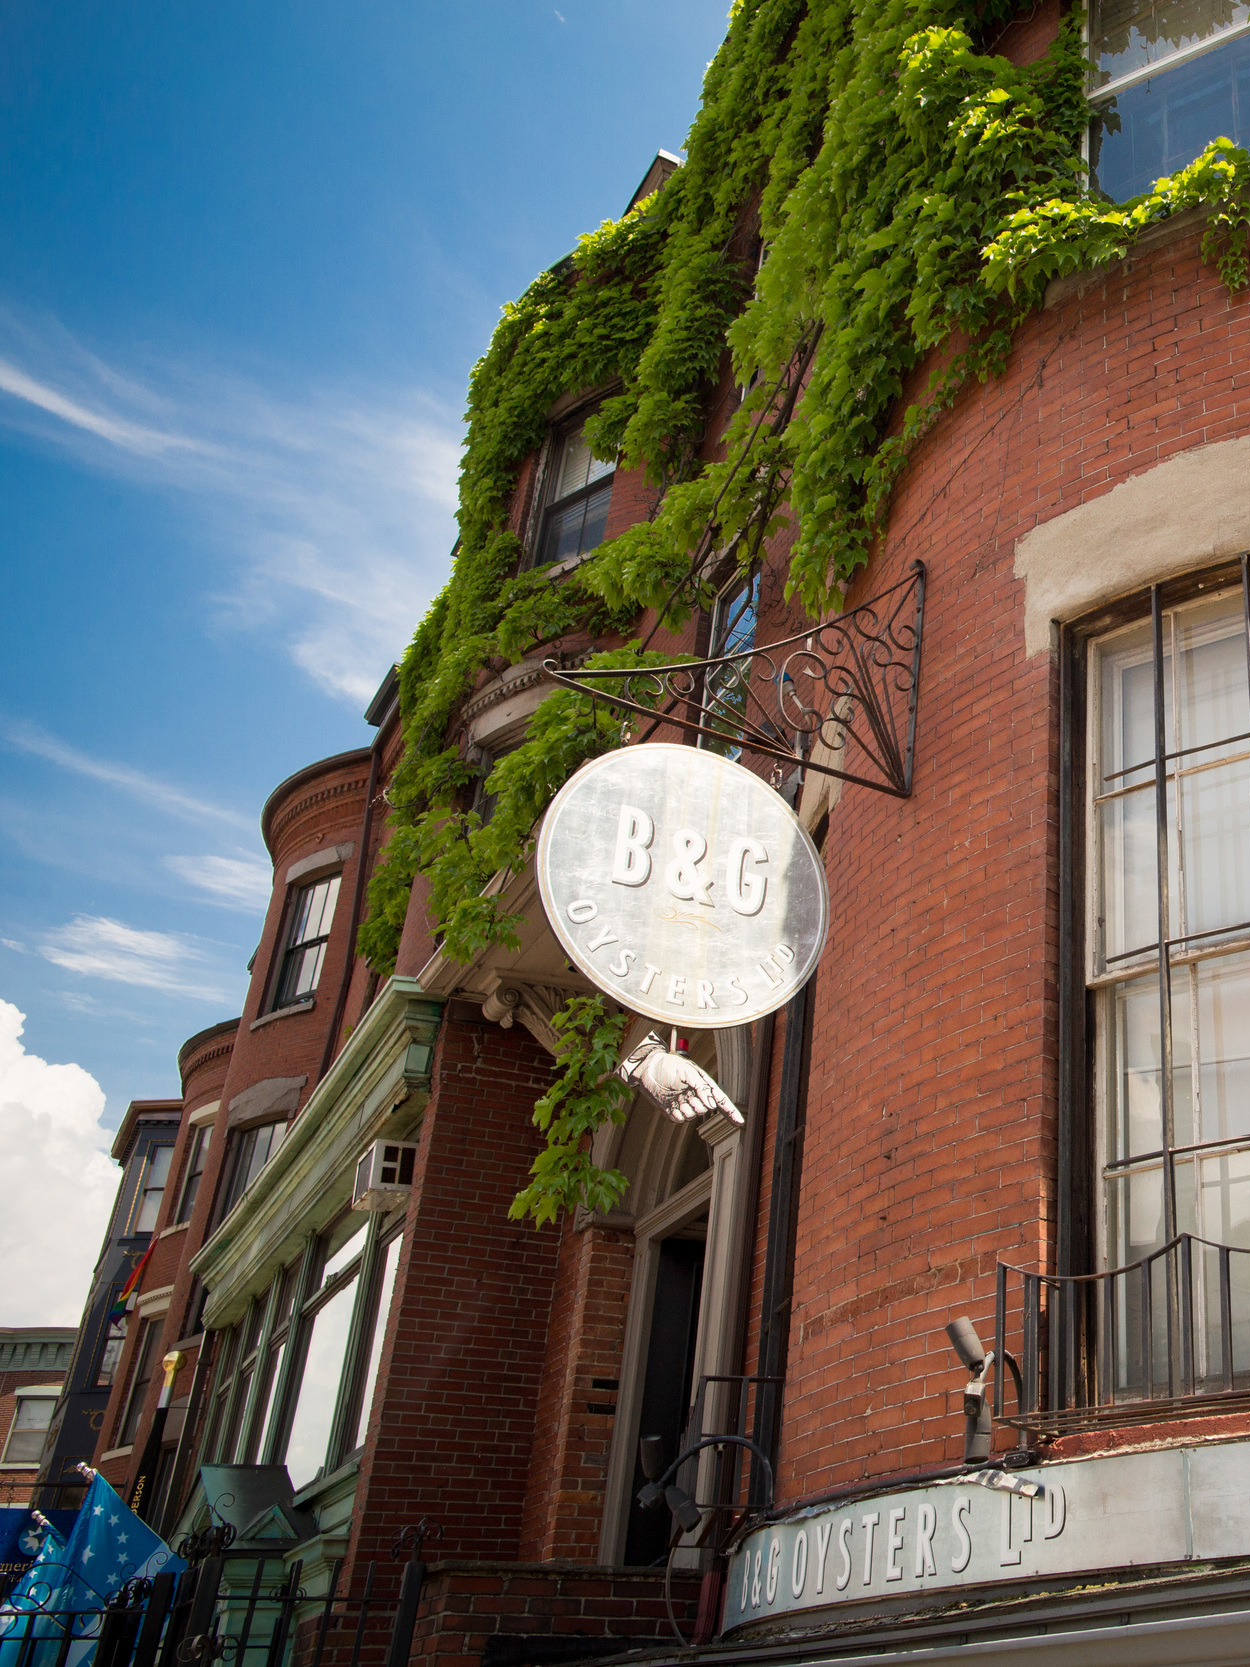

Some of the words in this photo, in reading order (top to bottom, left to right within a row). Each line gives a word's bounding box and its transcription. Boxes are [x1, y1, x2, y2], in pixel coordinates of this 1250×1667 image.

[612, 804, 769, 916] B&G
[566, 899, 748, 1010] OYSTERS
[756, 943, 796, 991] LTD
[740, 1537, 781, 1614] B&G
[791, 1496, 972, 1600] OYSTERS
